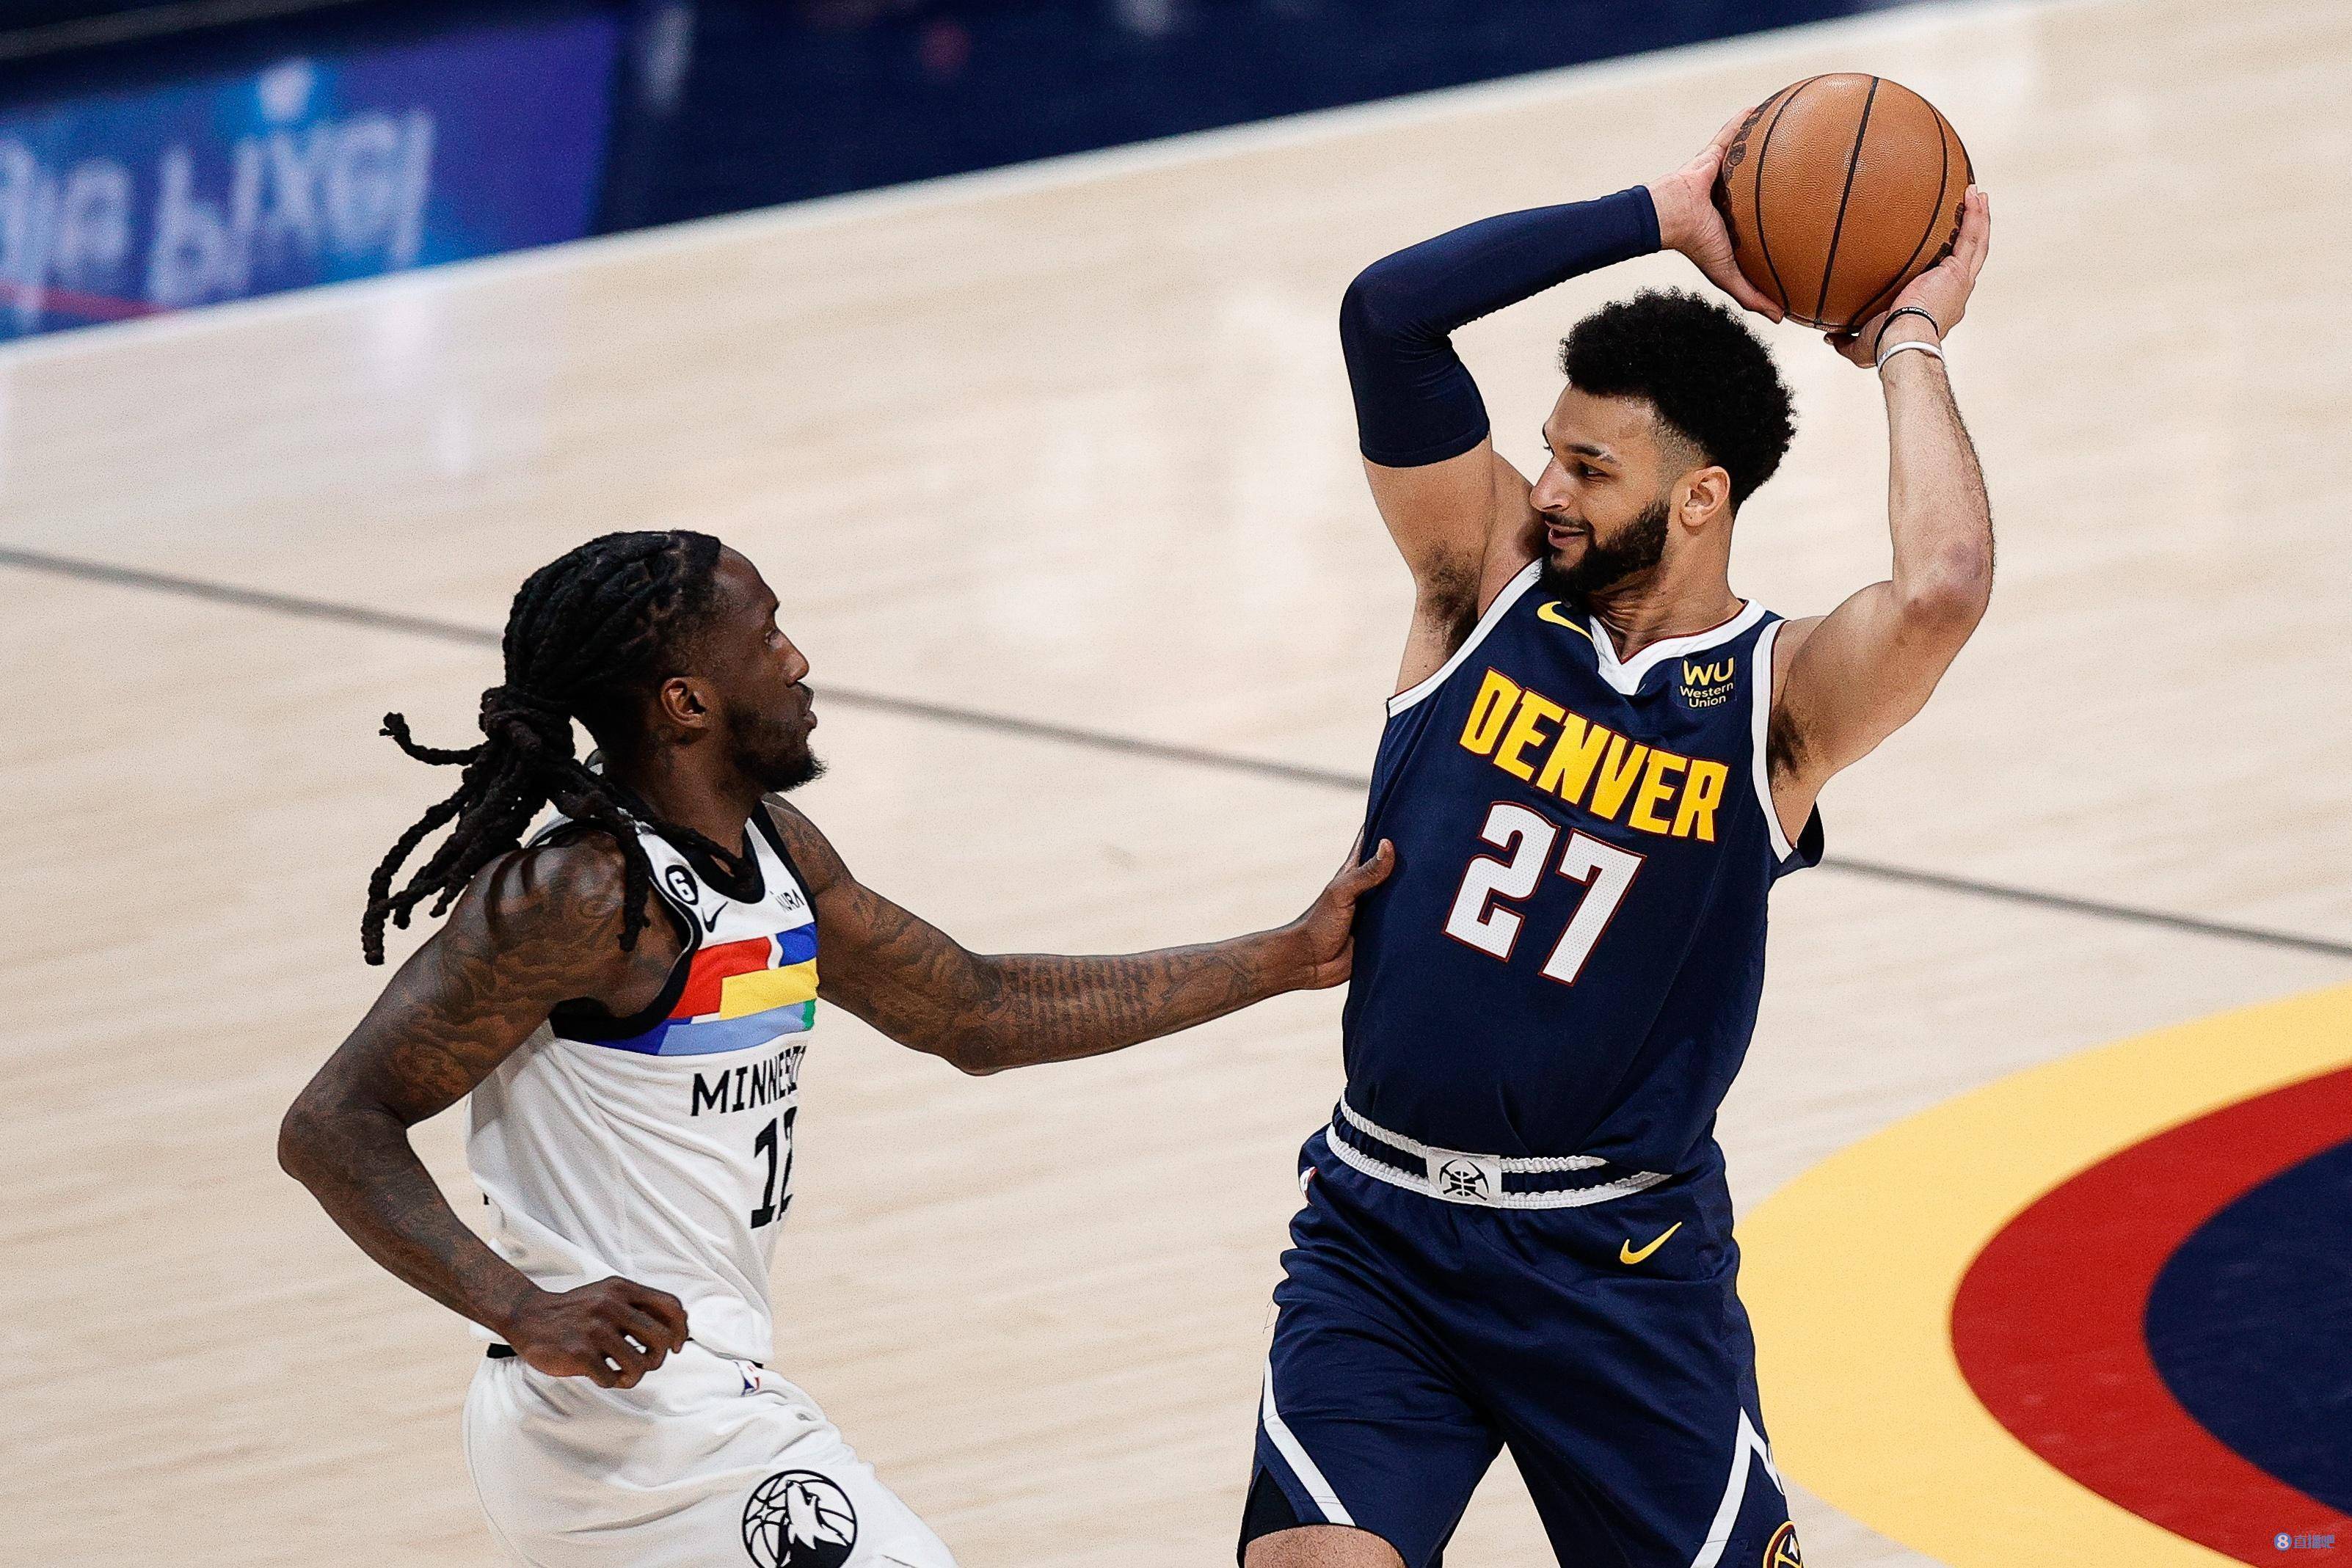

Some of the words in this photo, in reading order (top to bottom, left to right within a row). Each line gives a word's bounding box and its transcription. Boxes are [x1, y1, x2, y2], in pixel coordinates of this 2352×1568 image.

[1683, 657, 1734, 685] WU
[1679, 682, 1733, 698] Western
[1689, 696, 1726, 708] Union
[1459, 666, 1729, 843] DENVER
[669, 870, 696, 902] 6
[1442, 800, 1648, 987] 27
